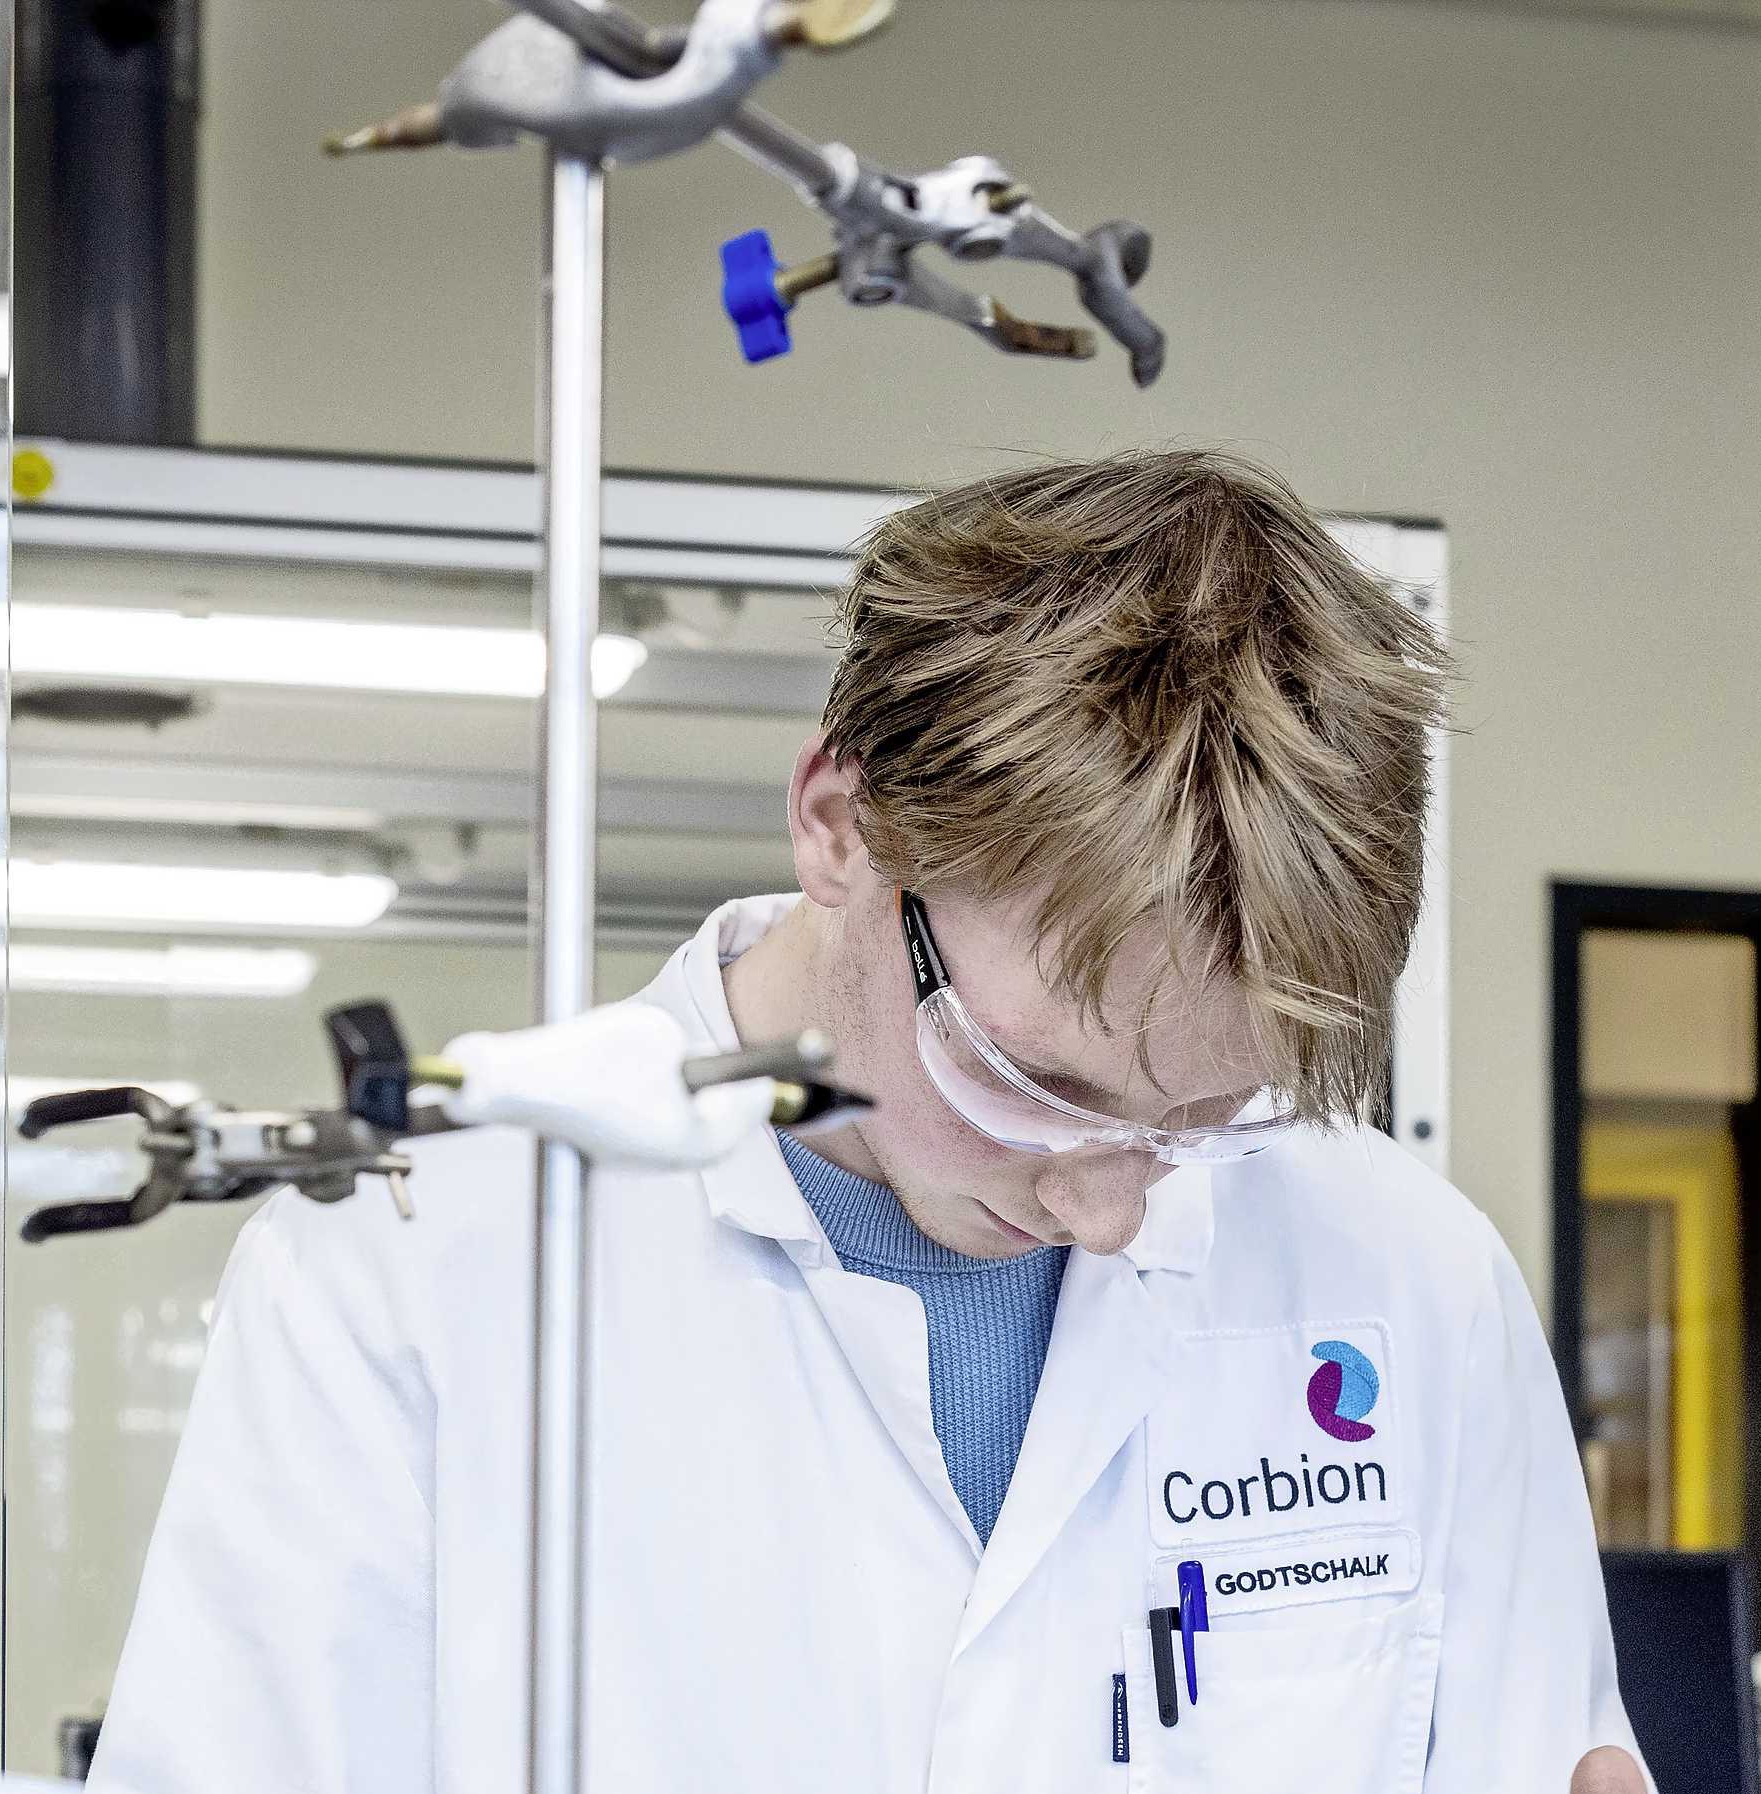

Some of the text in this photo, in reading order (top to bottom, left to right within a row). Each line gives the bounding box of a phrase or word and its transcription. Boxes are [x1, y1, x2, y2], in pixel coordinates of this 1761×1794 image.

[912, 939, 928, 984] bollé
[1163, 1453, 1387, 1524] Corbion
[1215, 1554, 1390, 1595] GODTSCHALK
